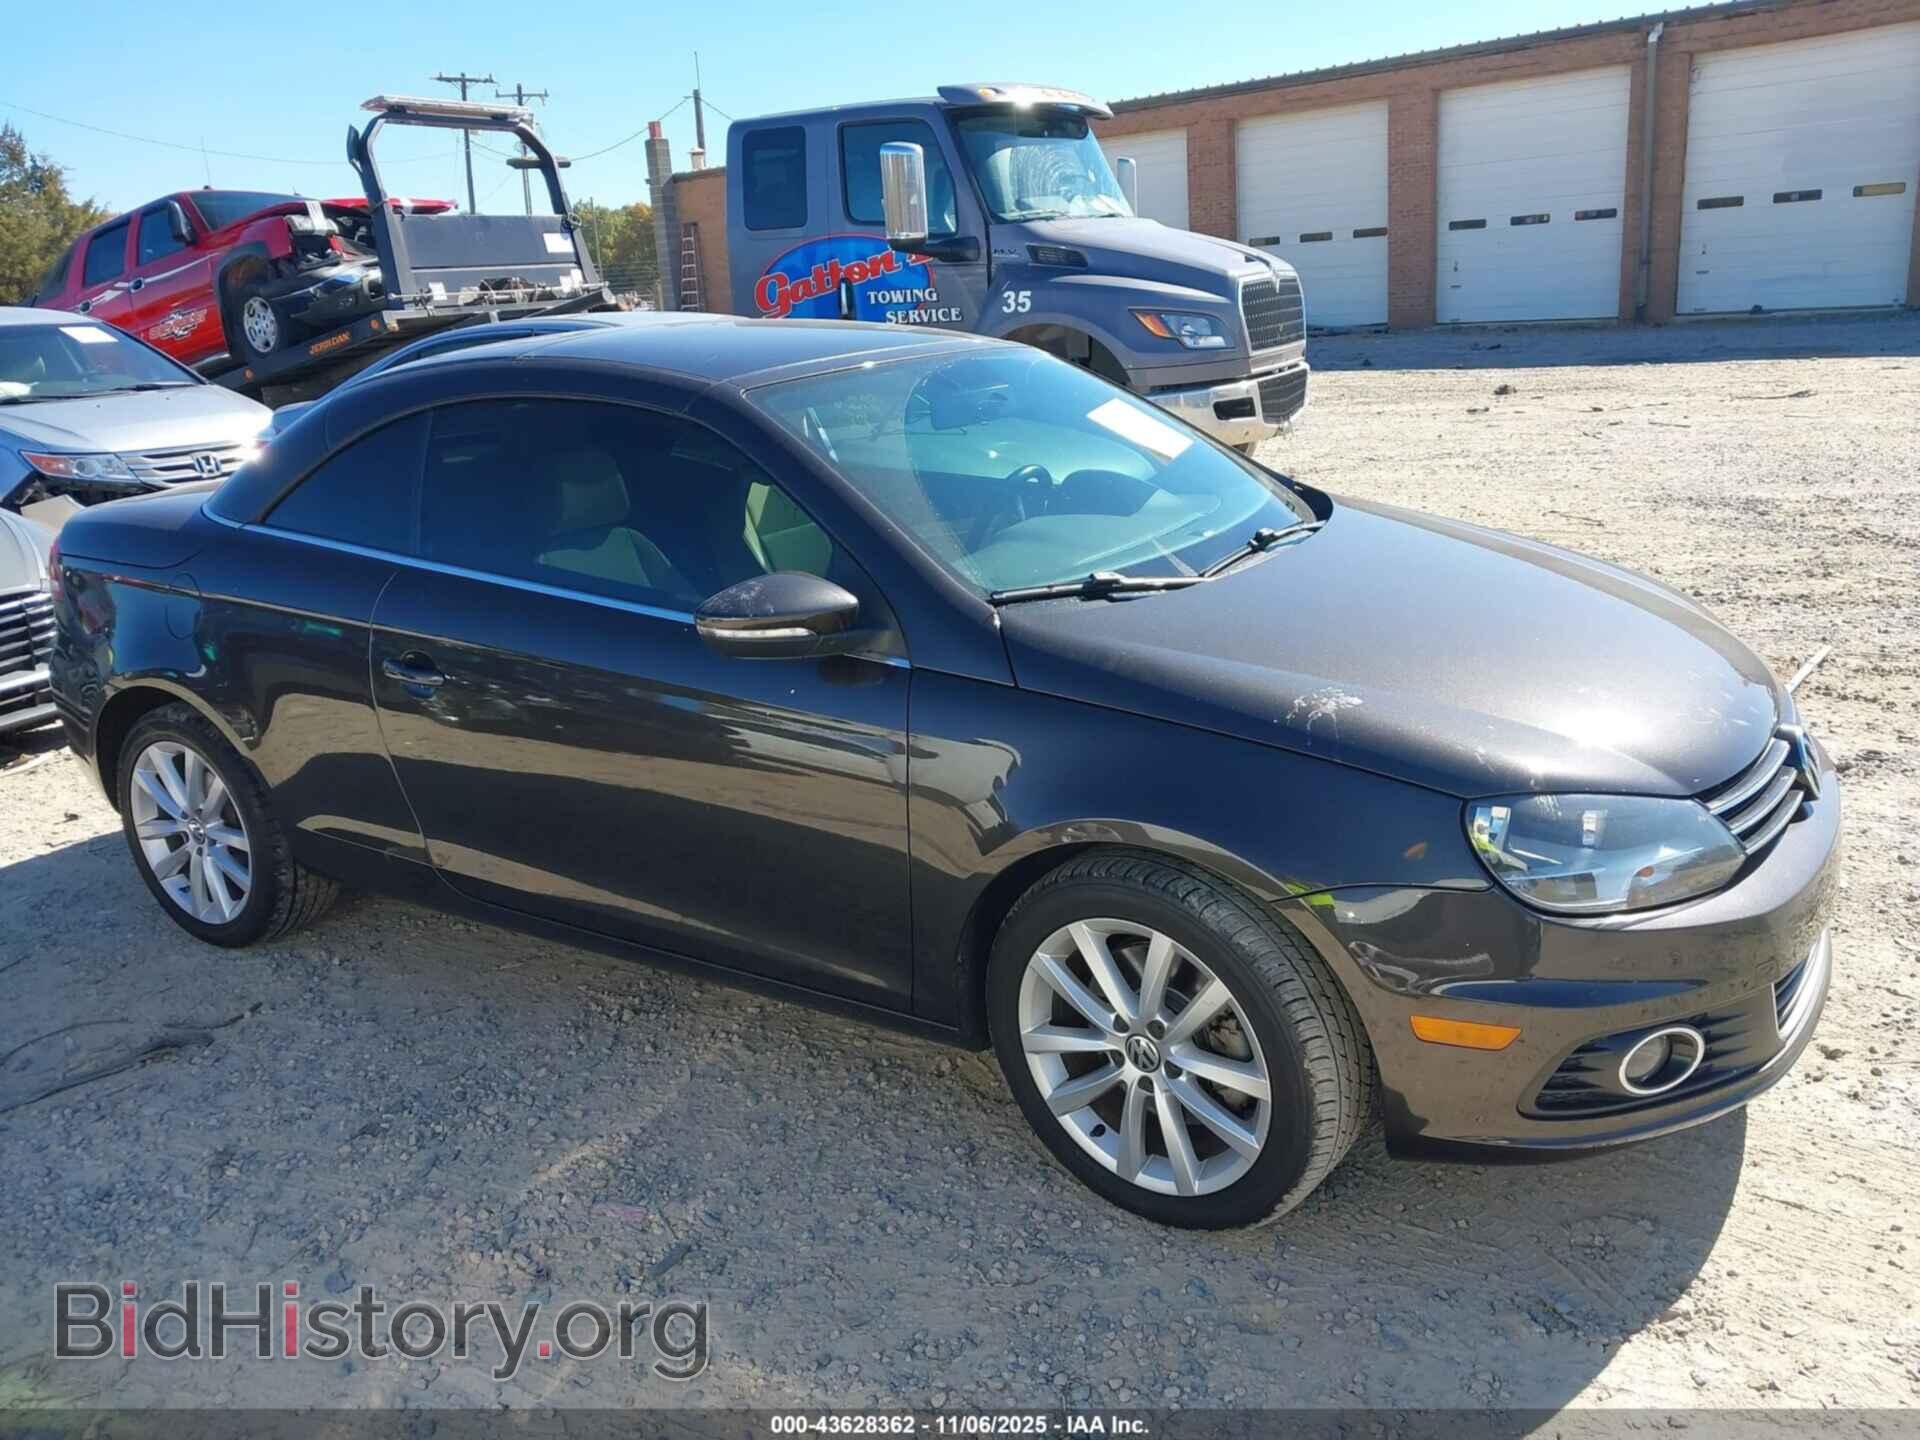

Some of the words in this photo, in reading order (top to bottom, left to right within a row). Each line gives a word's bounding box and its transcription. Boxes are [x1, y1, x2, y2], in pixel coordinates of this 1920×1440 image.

[755, 249, 934, 319] Gatton
[867, 288, 938, 305] TOWING
[1002, 291, 1032, 314] 35
[885, 307, 962, 324] SERVICE
